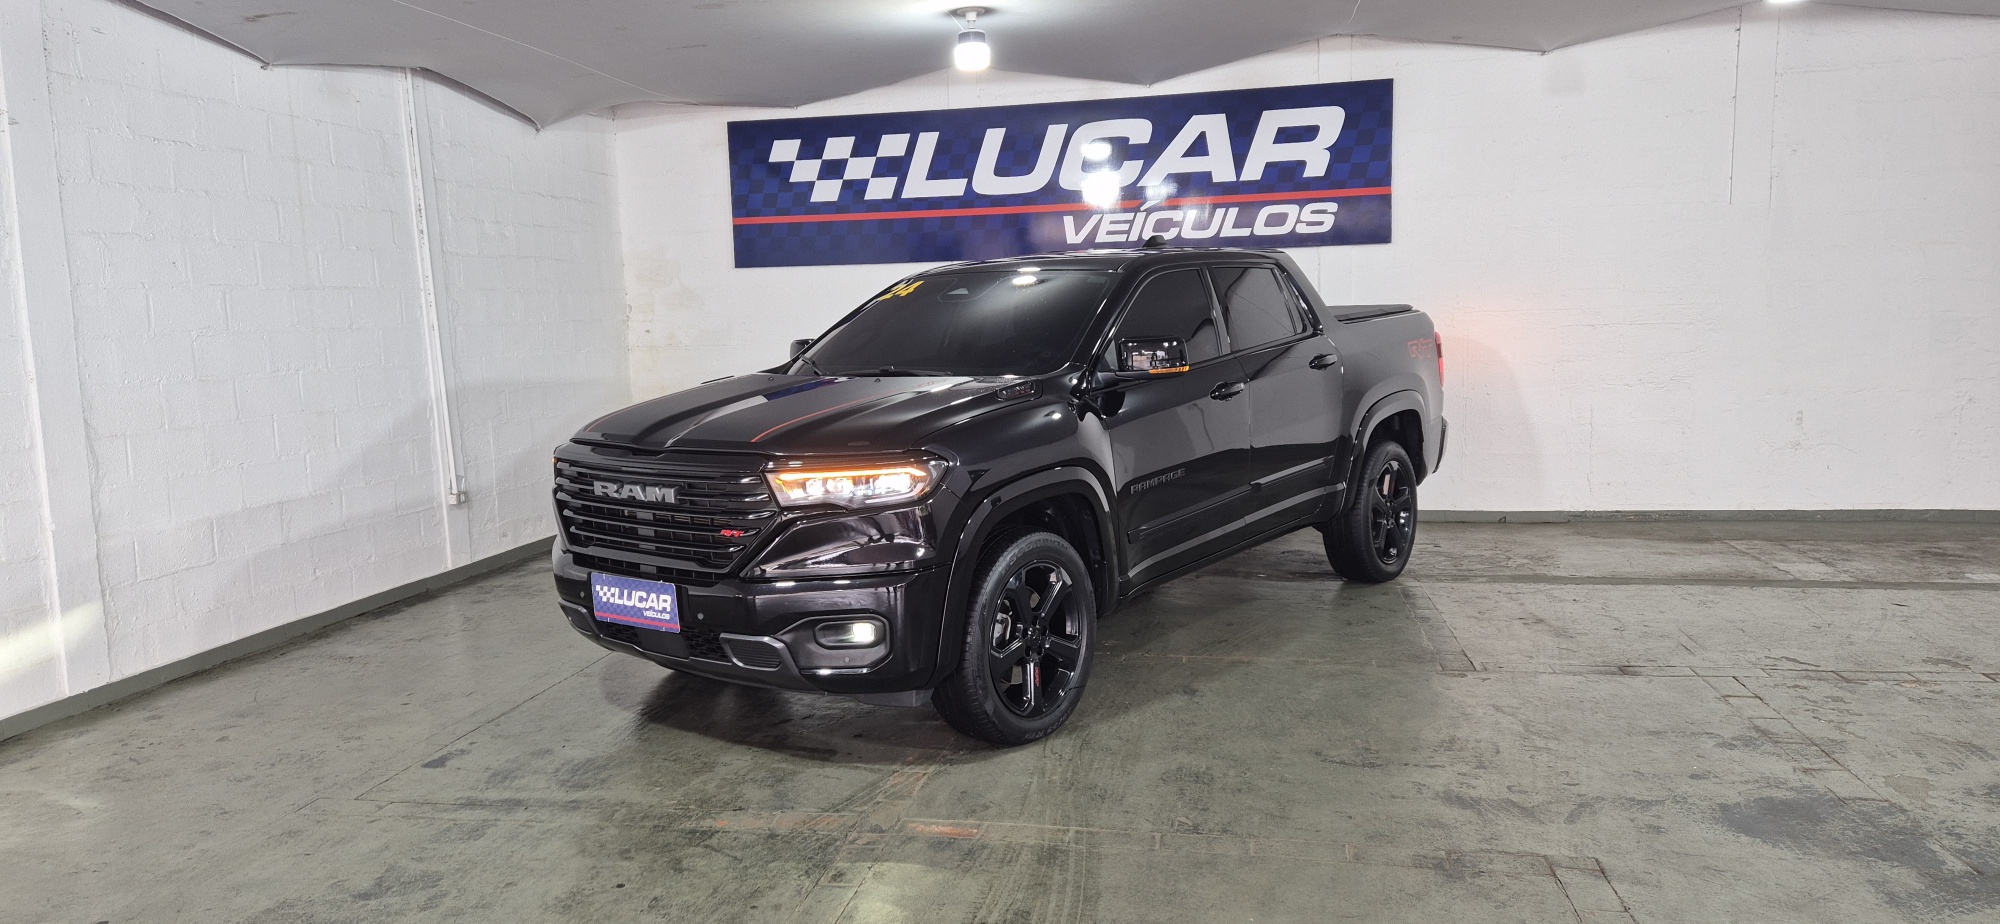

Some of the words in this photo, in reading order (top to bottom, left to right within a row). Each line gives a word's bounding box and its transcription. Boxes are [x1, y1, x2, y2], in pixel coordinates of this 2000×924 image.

[901, 105, 1345, 199] LUCAR
[1063, 200, 1338, 244] VEÍCULOS
[879, 280, 925, 300] 24
[594, 481, 678, 503] RAM
[1131, 468, 1186, 494] RAMPAGE
[614, 588, 672, 612] LUCAR
[643, 610, 670, 620] VEÍCULOS
